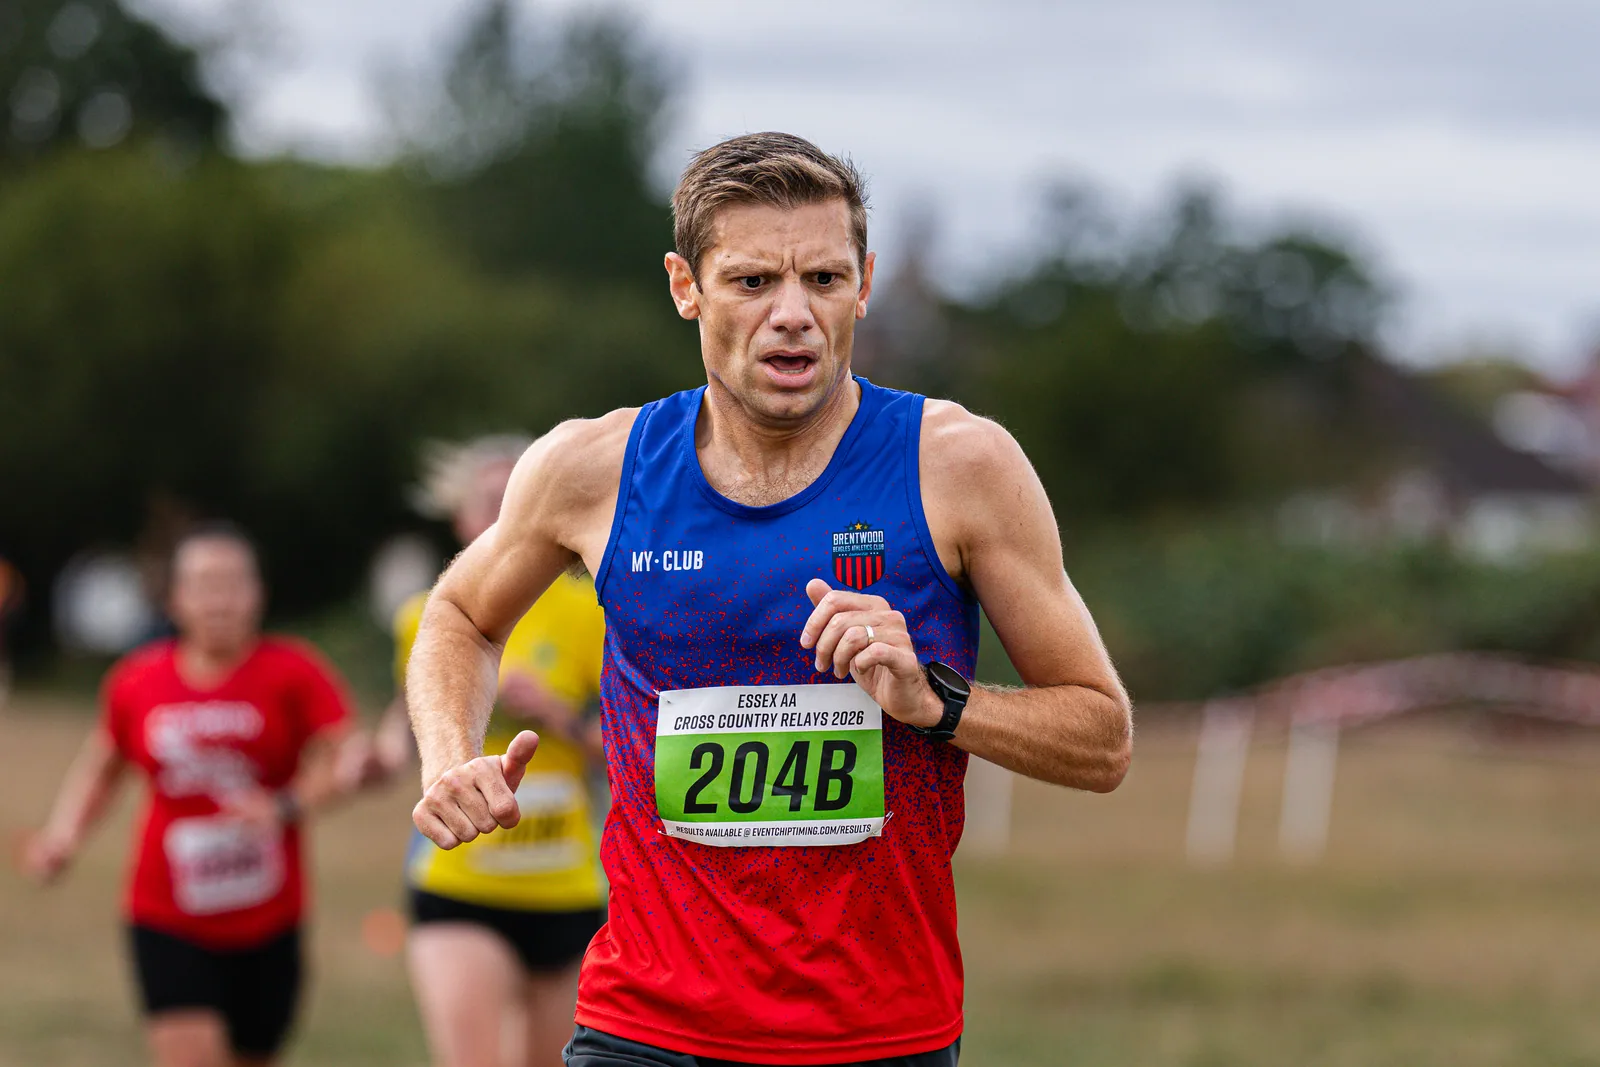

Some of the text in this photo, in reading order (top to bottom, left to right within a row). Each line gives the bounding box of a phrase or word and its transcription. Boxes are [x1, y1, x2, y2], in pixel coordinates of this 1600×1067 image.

[833, 530, 884, 546] BRENTWOOD
[738, 692, 797, 709] ESSEX AA
[674, 710, 865, 731] CROSS COUNTRY RELAYS 2026
[683, 739, 858, 814] 204B
[675, 823, 872, 837] RESULTS AVAILABLE @ EVENTCHIPTIMING.COM/RESULTS
